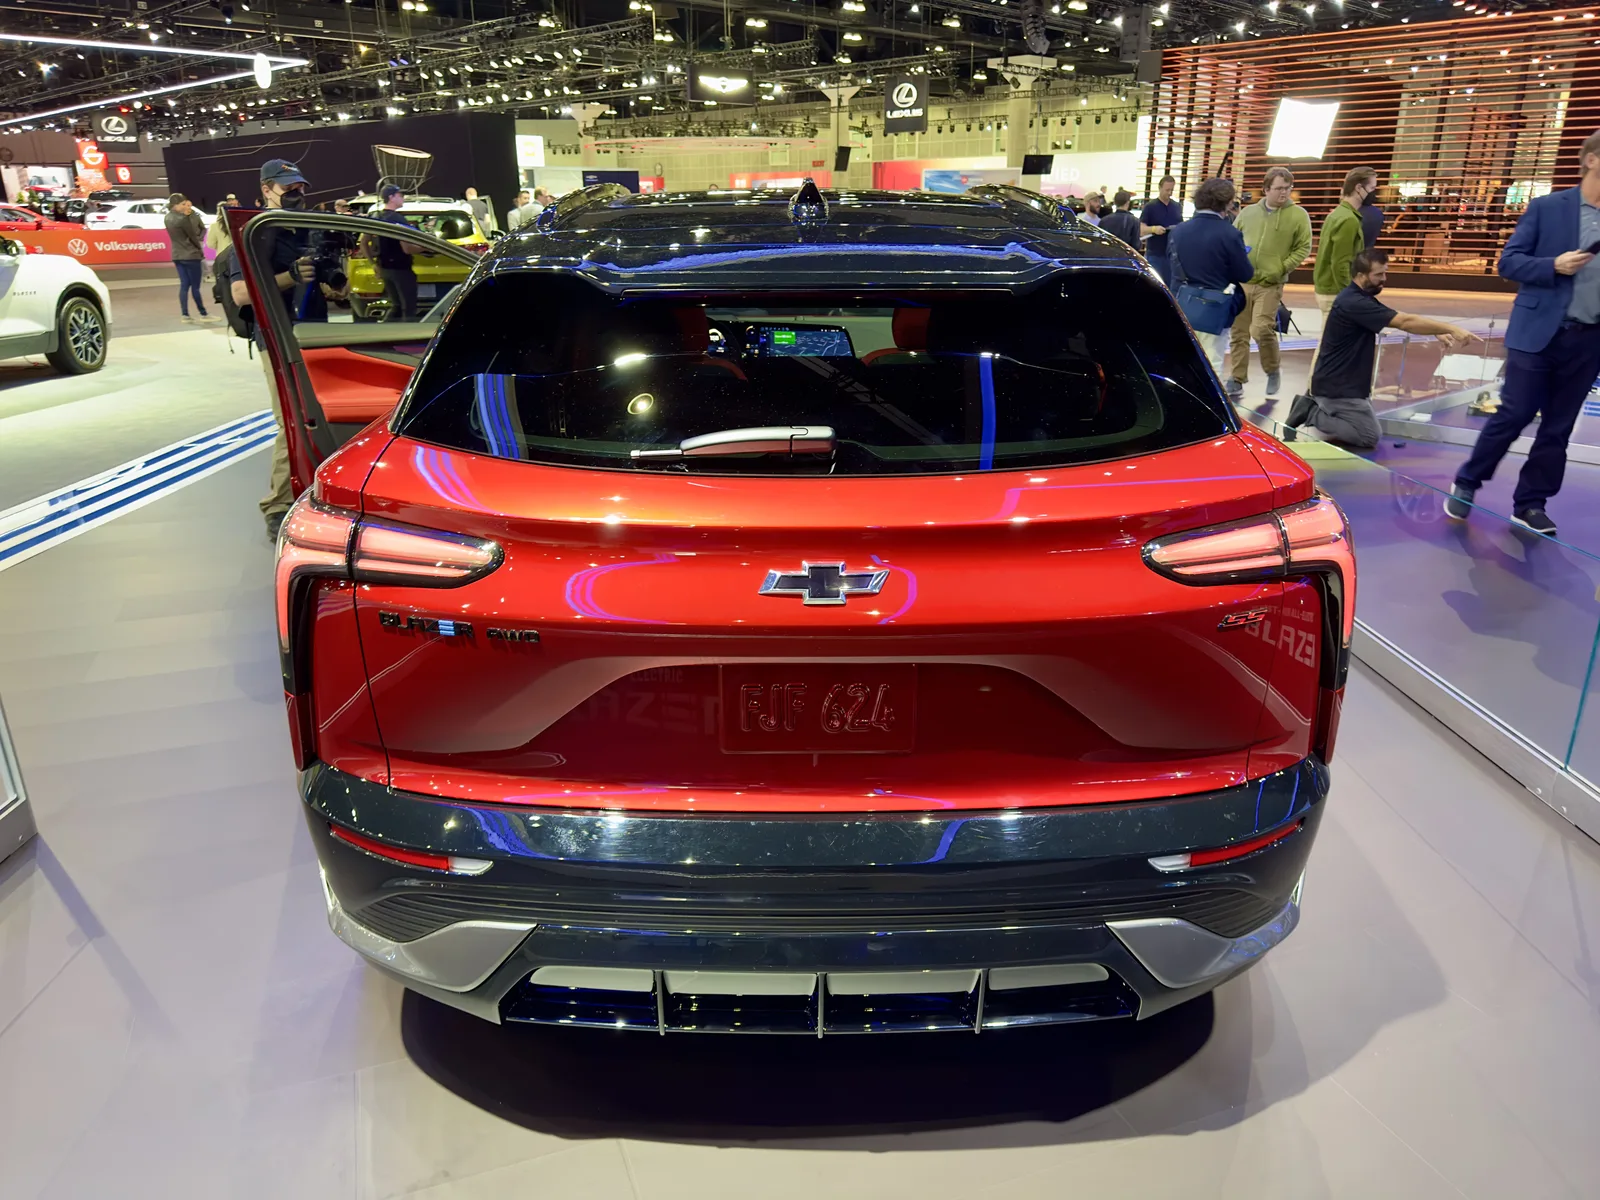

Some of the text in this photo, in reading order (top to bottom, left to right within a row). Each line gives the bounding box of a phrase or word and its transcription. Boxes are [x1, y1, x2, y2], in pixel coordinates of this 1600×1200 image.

[886, 108, 923, 119] LEXUS
[96, 135, 138, 143] LEXUS
[94, 241, 166, 252] Volkswagen
[378, 610, 540, 643] BLAZER AWD
[741, 683, 896, 734] FJF 624
